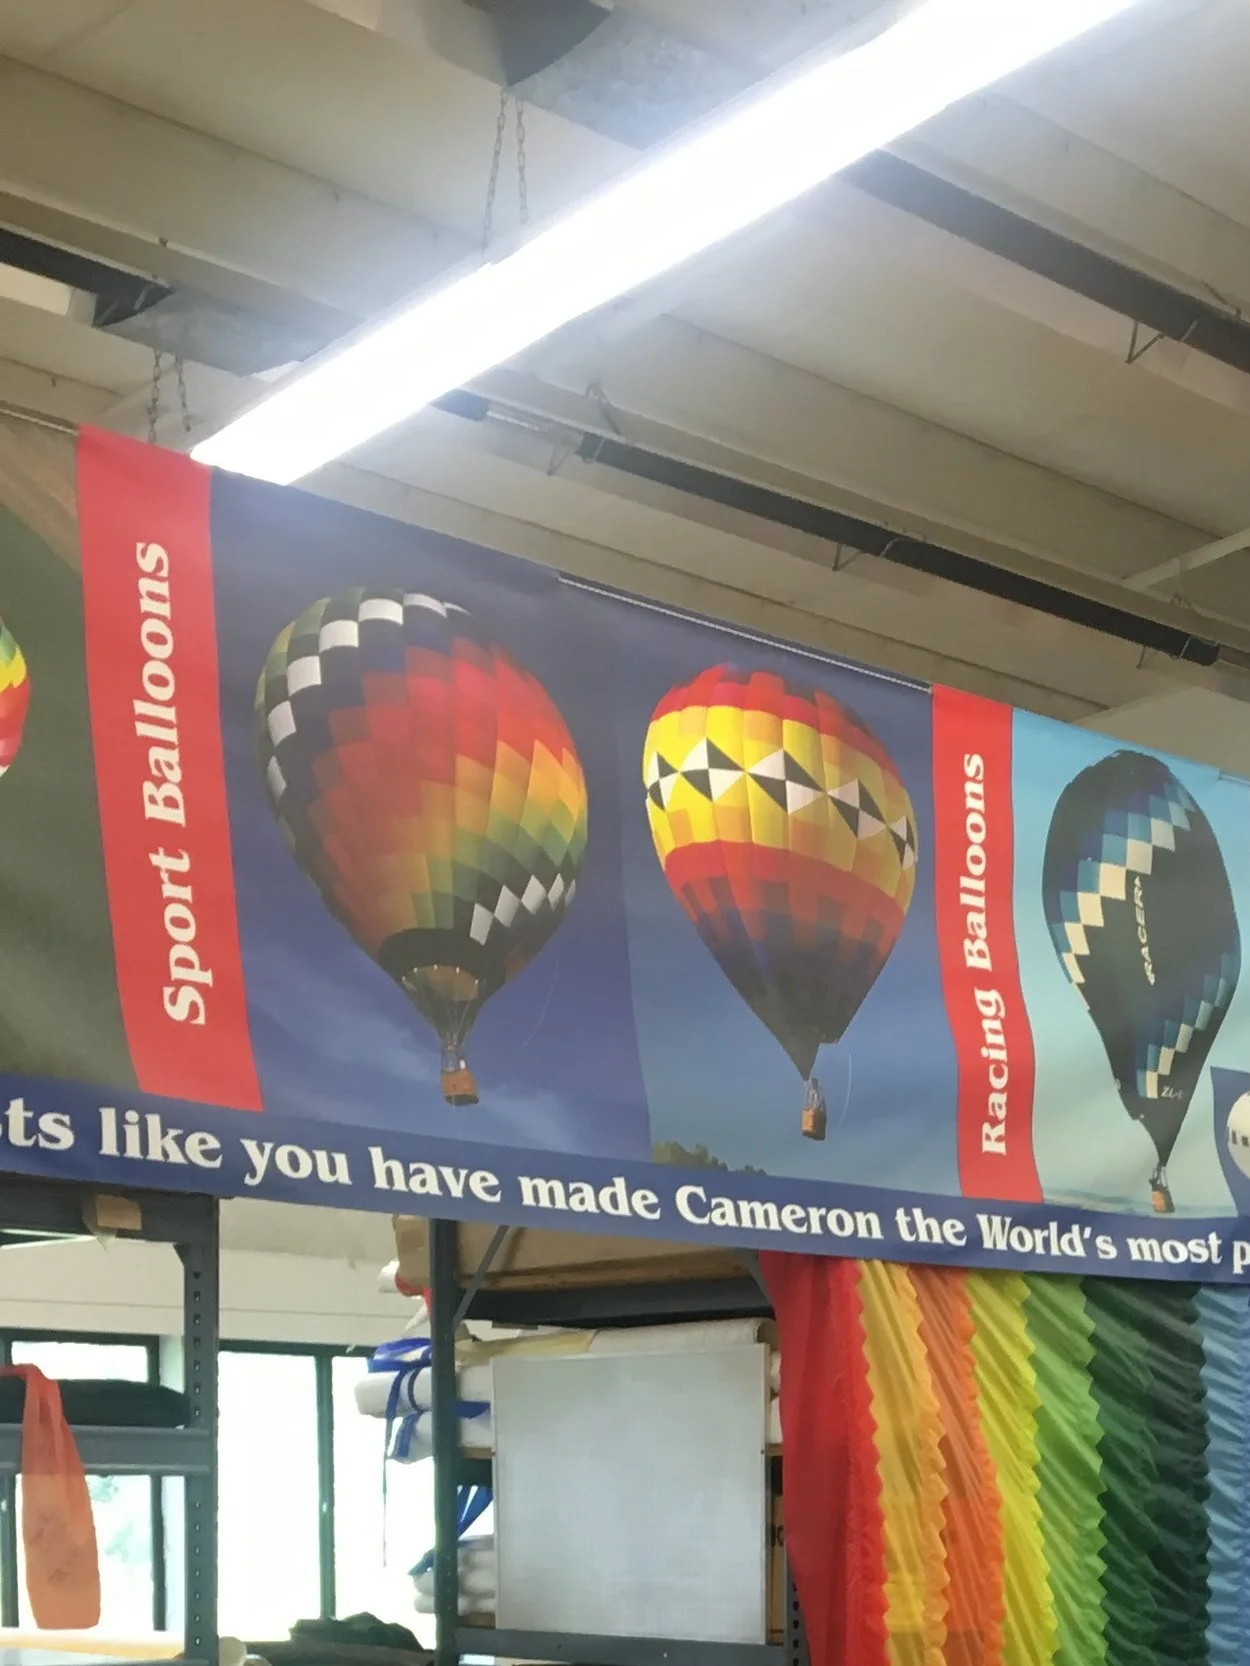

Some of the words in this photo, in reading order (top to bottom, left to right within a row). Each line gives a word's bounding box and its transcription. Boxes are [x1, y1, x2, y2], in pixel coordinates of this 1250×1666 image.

[133, 541, 186, 827] Balloons
[148, 847, 213, 1025] Sport
[959, 753, 992, 972] Balloons
[975, 987, 1007, 1156] Racing
[0, 1097, 75, 1151] ts
[98, 1106, 223, 1168] like
[239, 1138, 352, 1186] you
[368, 1146, 501, 1202] have
[517, 1176, 661, 1220] made
[676, 1185, 884, 1240] Cameron
[895, 1207, 967, 1246] the
[976, 1213, 1118, 1260] World's
[1126, 1231, 1222, 1264] most
